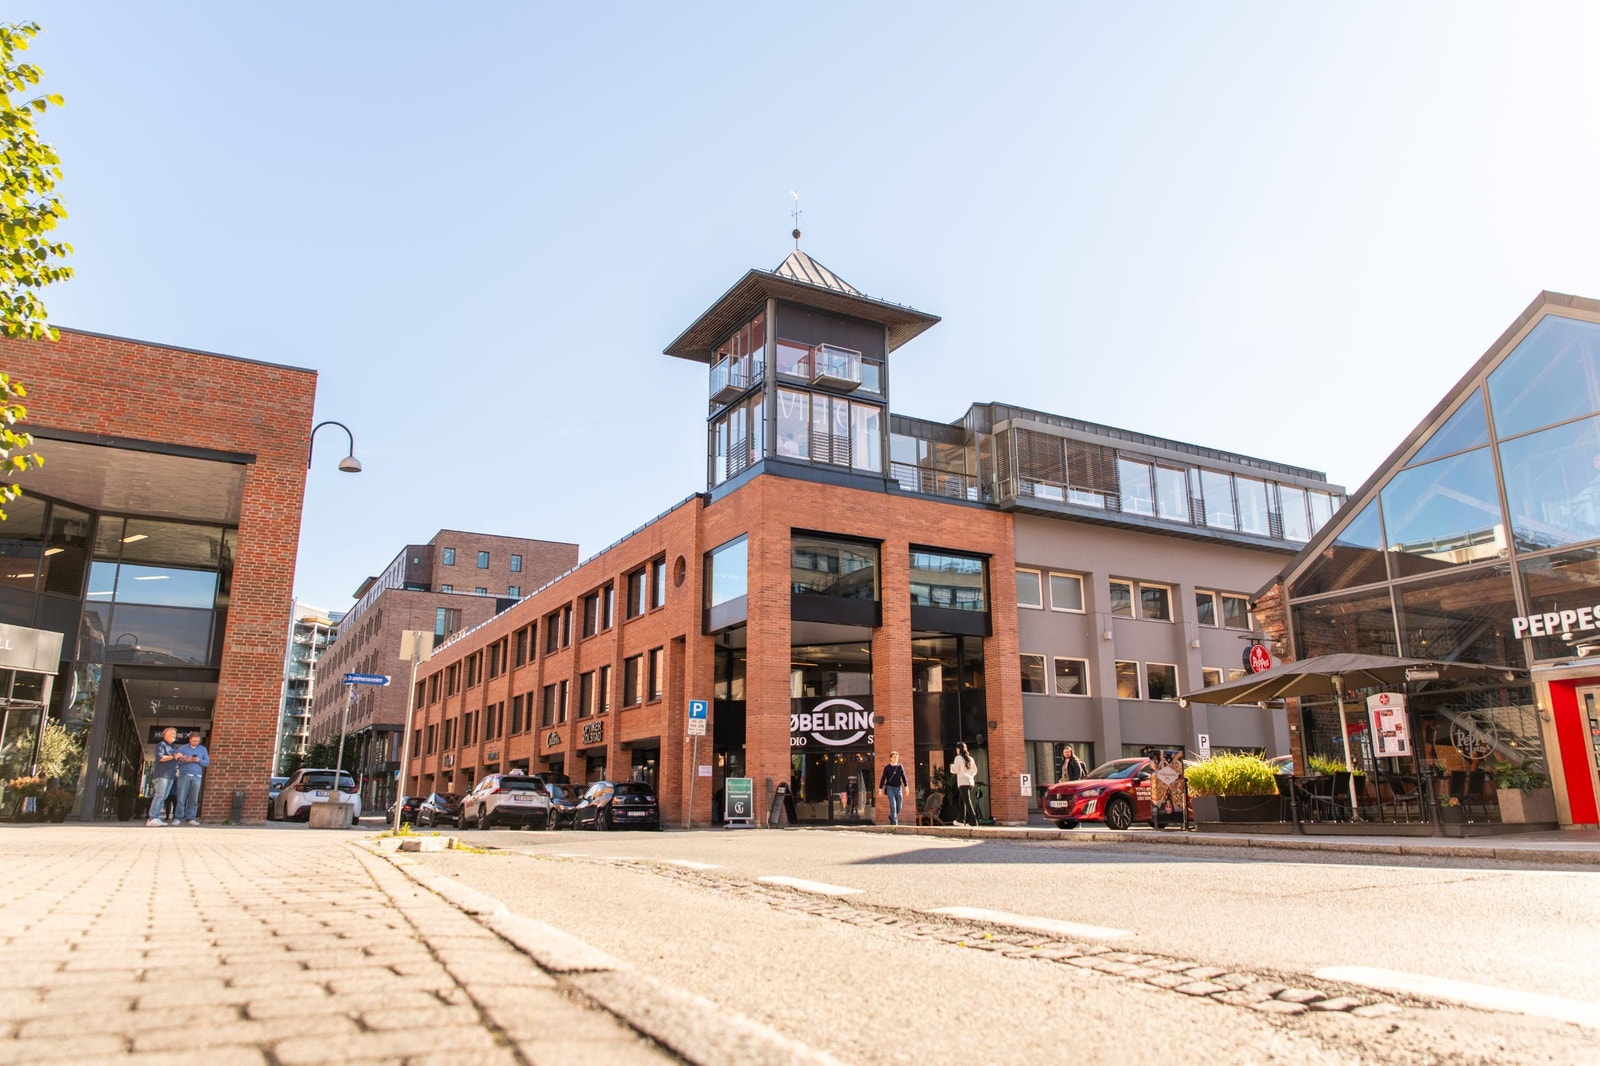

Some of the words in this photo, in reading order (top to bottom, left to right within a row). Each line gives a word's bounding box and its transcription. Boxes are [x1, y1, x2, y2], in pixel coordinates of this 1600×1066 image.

[167, 704, 207, 712] SLETTVOLL
[693, 702, 703, 717] P
[867, 735, 874, 744] S
[1022, 775, 1029, 786] P
